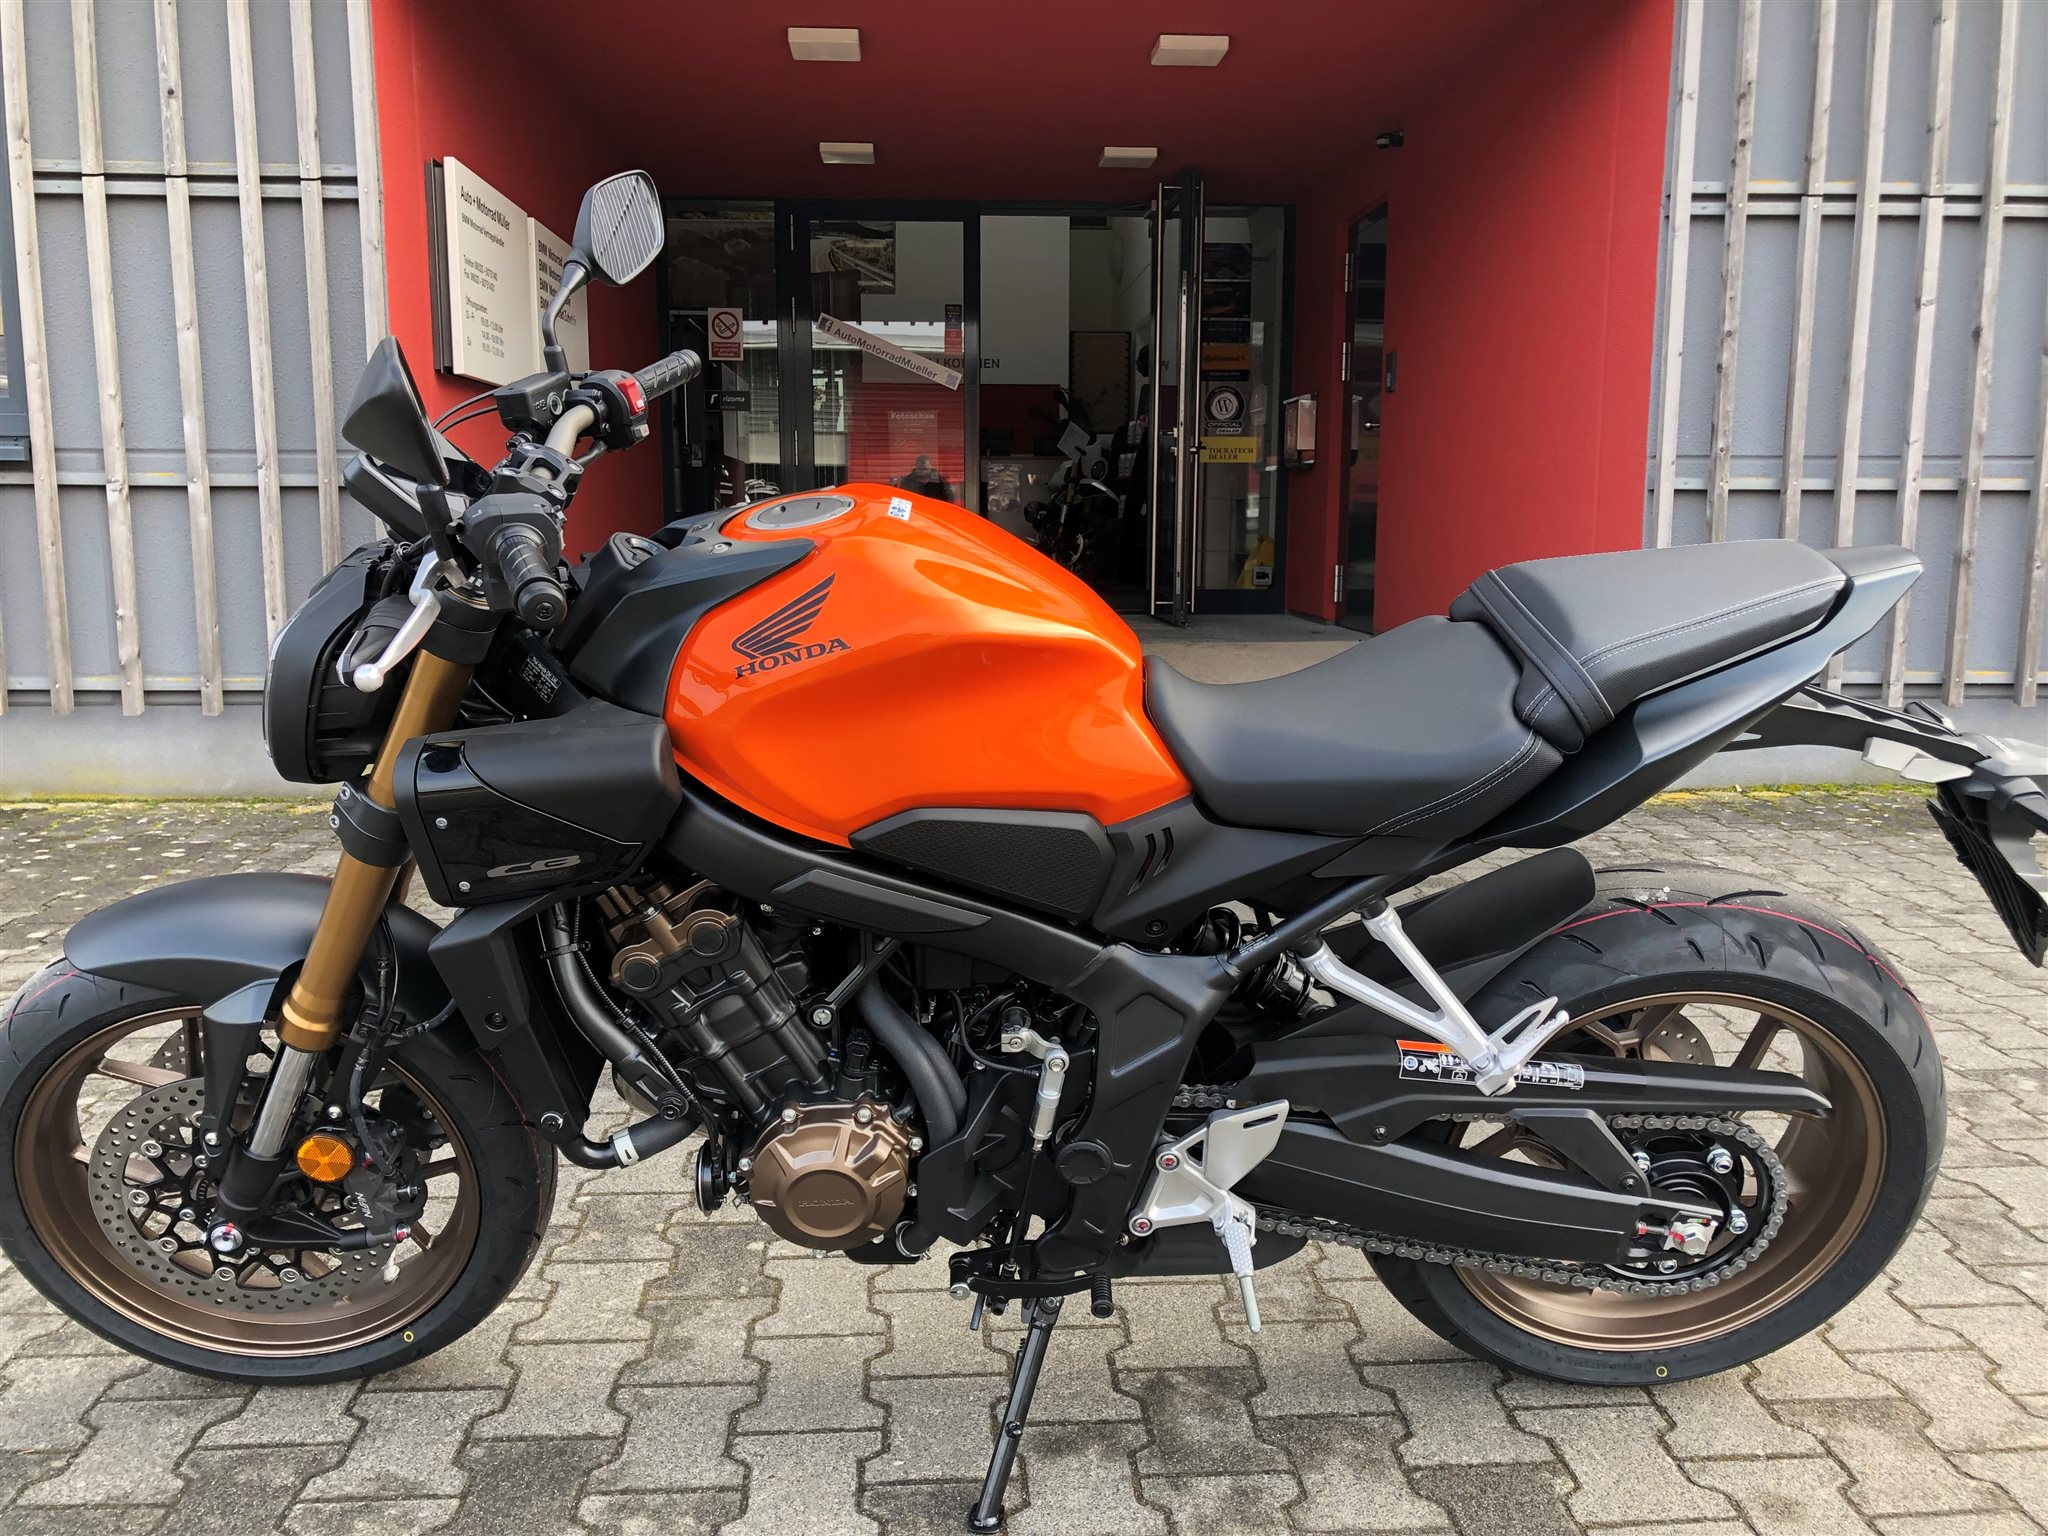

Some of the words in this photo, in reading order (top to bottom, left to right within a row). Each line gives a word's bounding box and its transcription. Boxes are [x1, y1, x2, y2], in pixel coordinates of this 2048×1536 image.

[461, 185, 472, 206] Auto
[538, 240, 547, 256] BMW
[539, 258, 548, 275] BMW
[539, 277, 549, 293] BMW
[833, 328, 939, 380] AutoMotorradMueller
[722, 395, 745, 403] rizoma
[735, 638, 852, 680] HONDA
[486, 855, 581, 878] CB
[355, 1192, 373, 1218] NISSIN
[798, 1198, 855, 1208] HONDA
